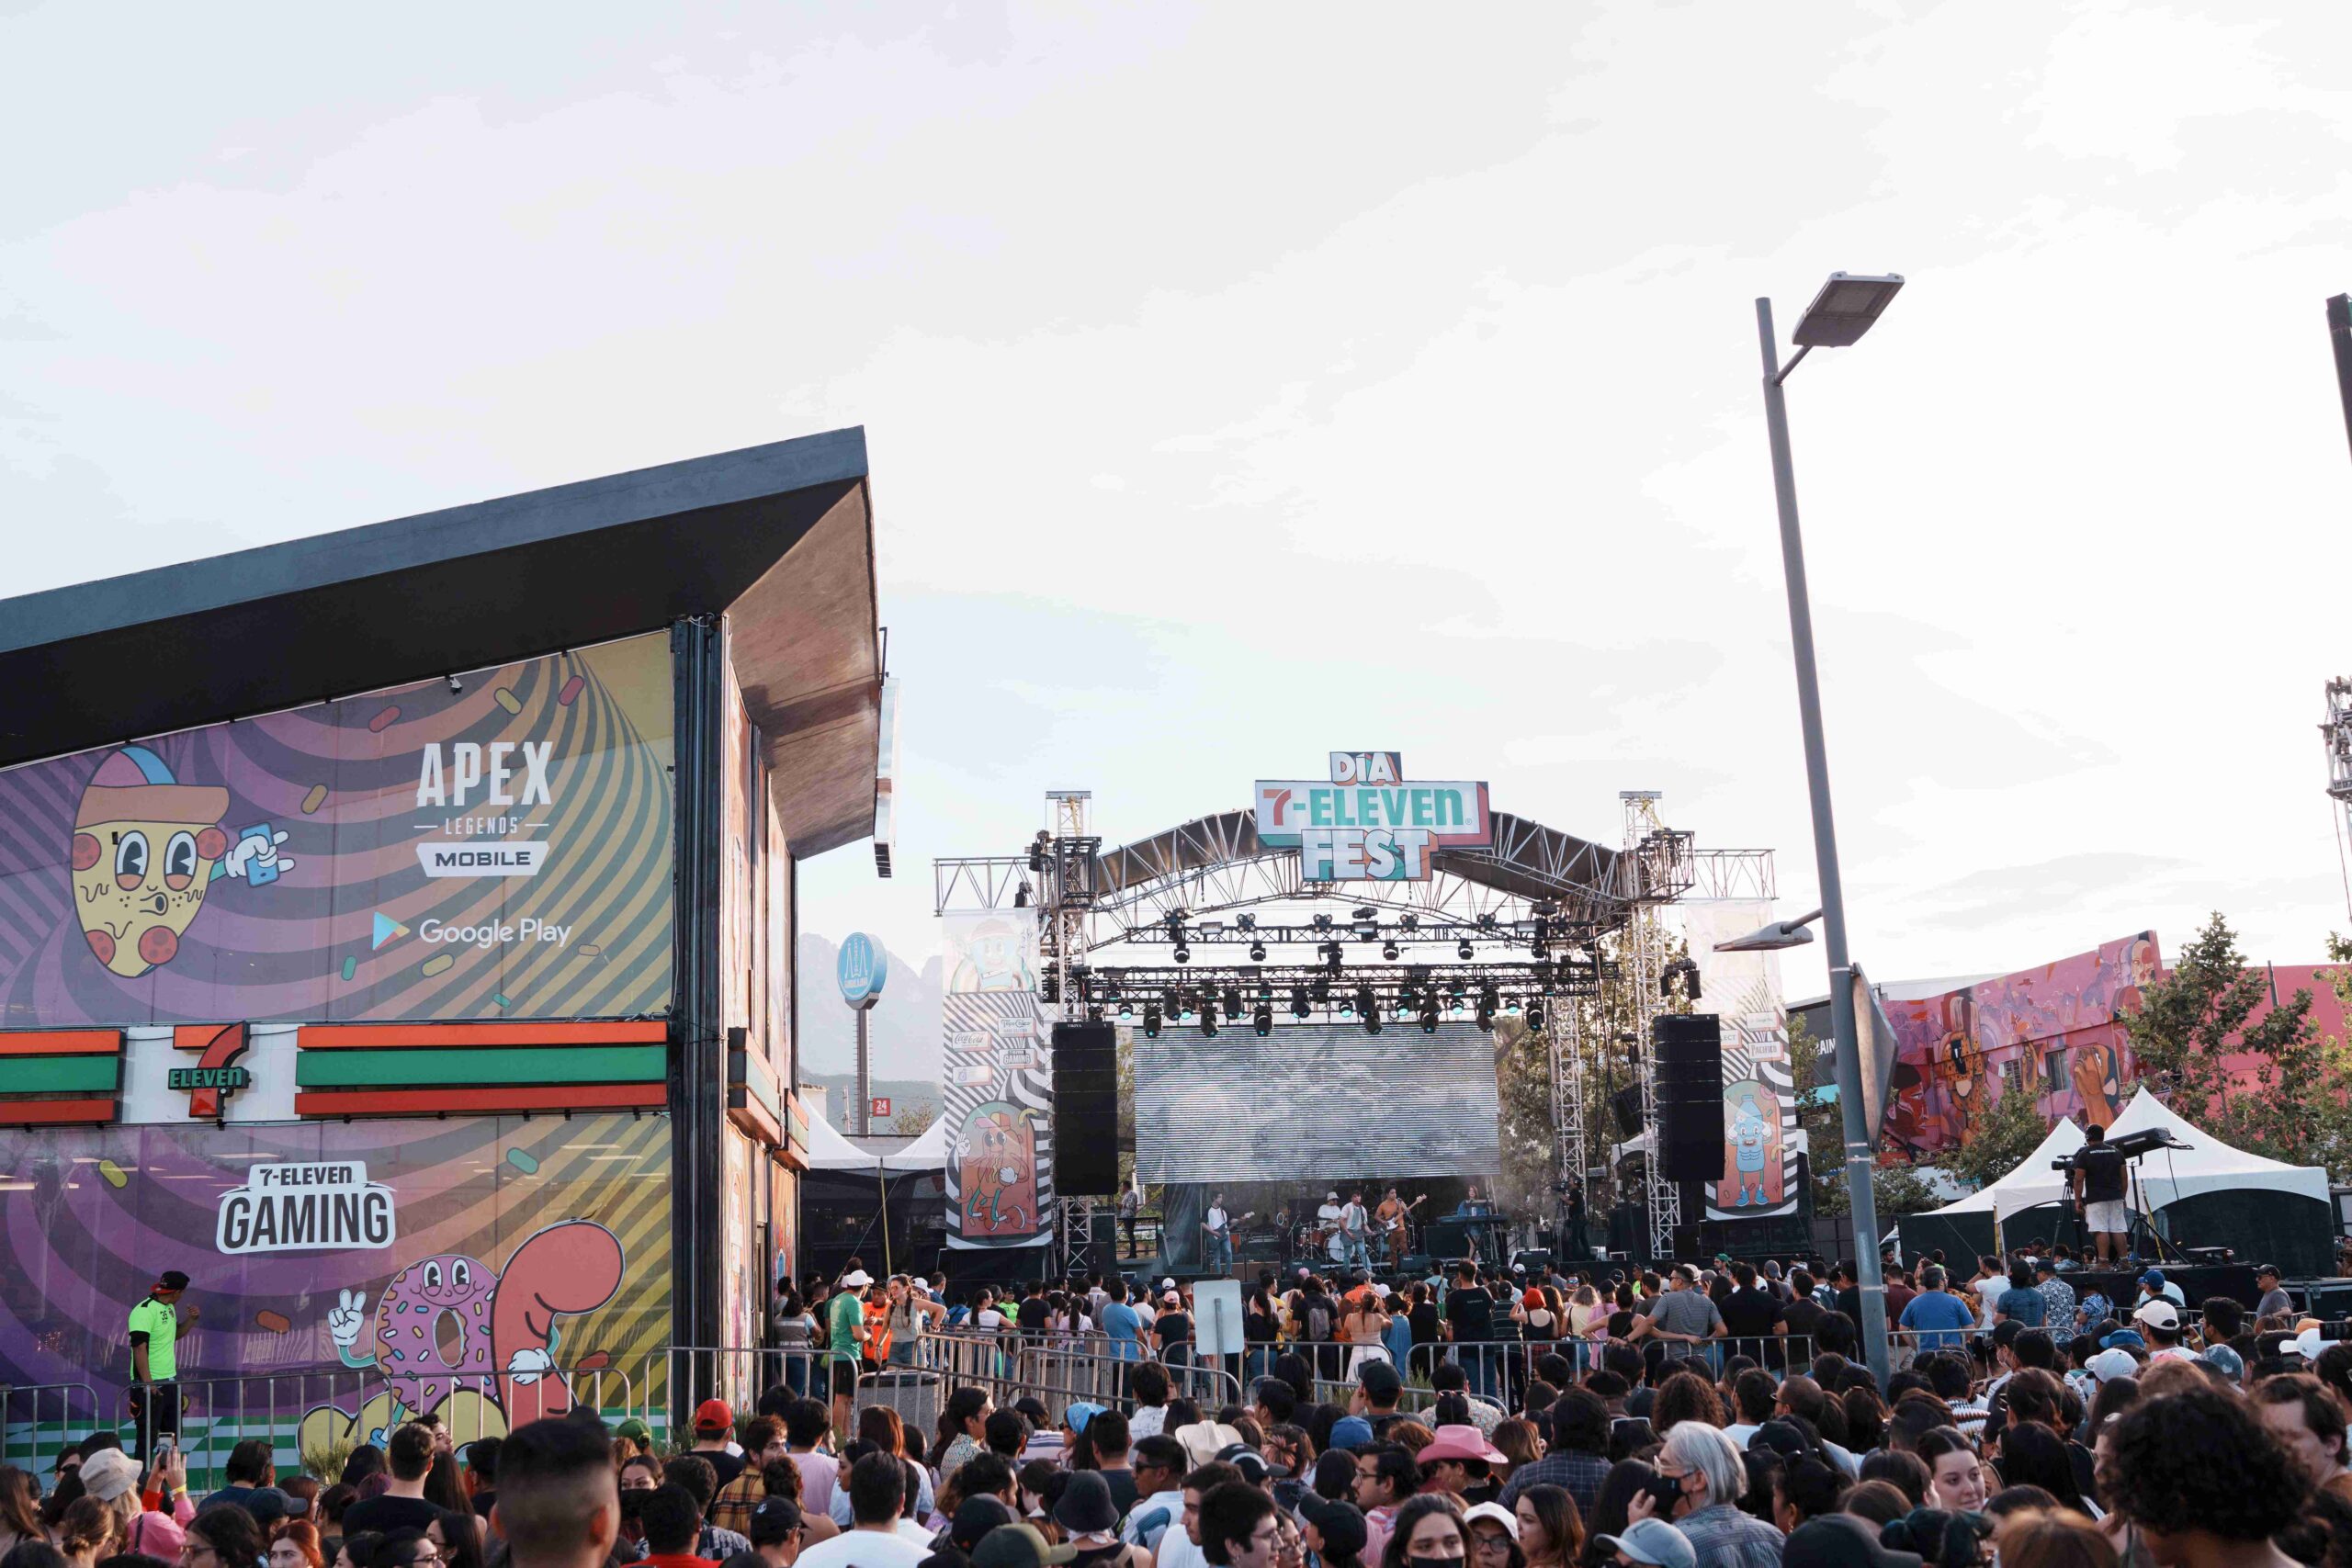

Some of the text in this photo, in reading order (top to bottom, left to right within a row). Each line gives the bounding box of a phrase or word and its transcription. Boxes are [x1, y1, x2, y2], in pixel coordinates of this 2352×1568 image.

[416, 741, 553, 807] APEX
[445, 817, 518, 835] LEGENDS
[435, 852, 531, 866] MOBILE
[1301, 829, 1432, 879] FEST
[419, 918, 572, 949] Google Play
[1003, 1055, 1031, 1065] GAMING
[876, 1100, 888, 1111] 24
[223, 1192, 389, 1249] GAMING
